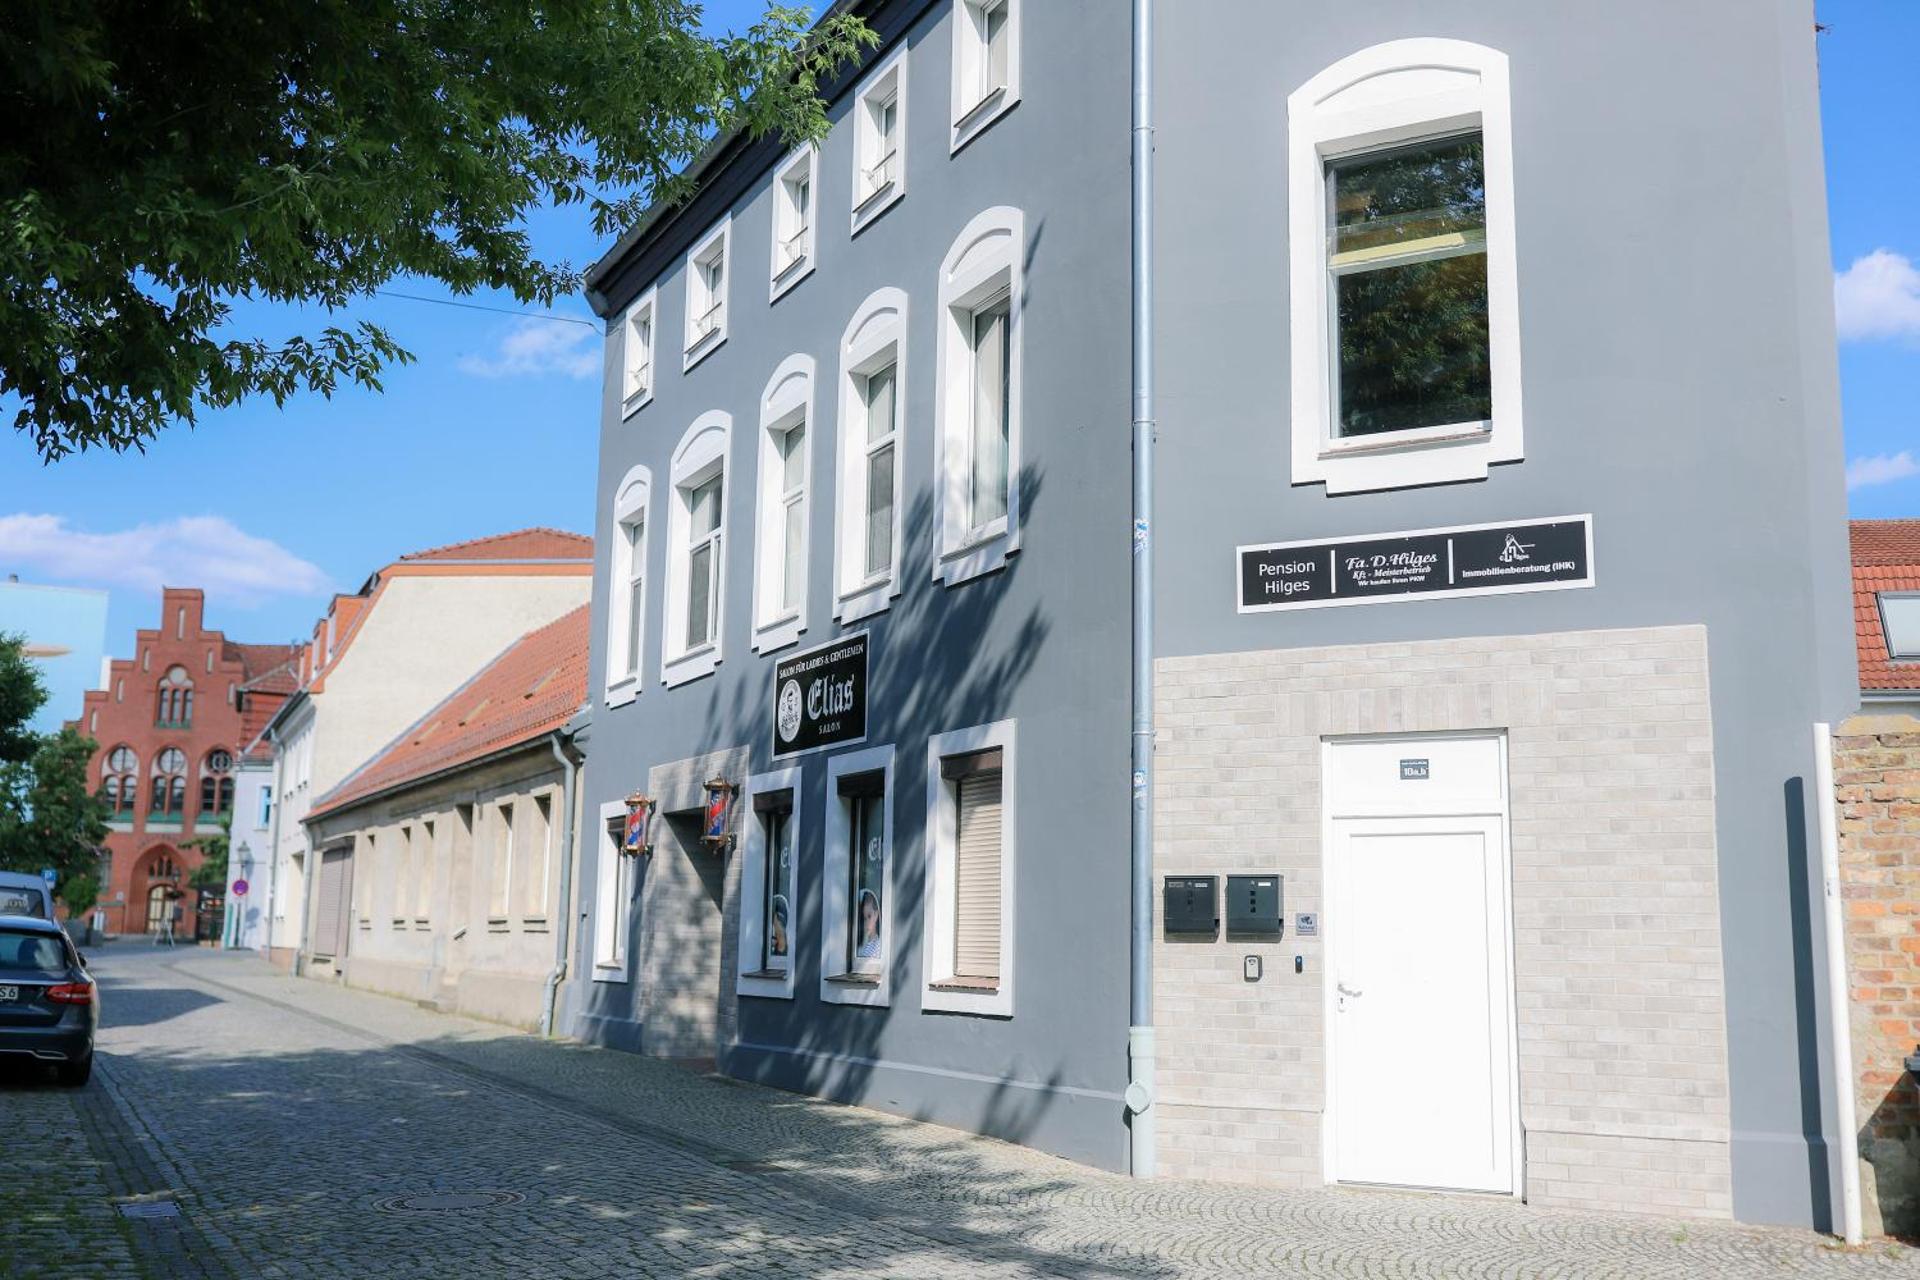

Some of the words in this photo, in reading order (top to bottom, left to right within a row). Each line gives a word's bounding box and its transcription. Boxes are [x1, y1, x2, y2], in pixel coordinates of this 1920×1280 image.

[1259, 561, 1316, 576] Pension
[1462, 563, 1551, 578] Immobilienberatung
[1552, 561, 1576, 571] (IHK)
[1265, 580, 1311, 595] Hilges
[779, 665, 796, 679] SALON
[824, 655, 830, 664] &
[830, 644, 864, 662] GENTLEMEN
[807, 673, 855, 720] Elias
[819, 721, 841, 734] SALON
